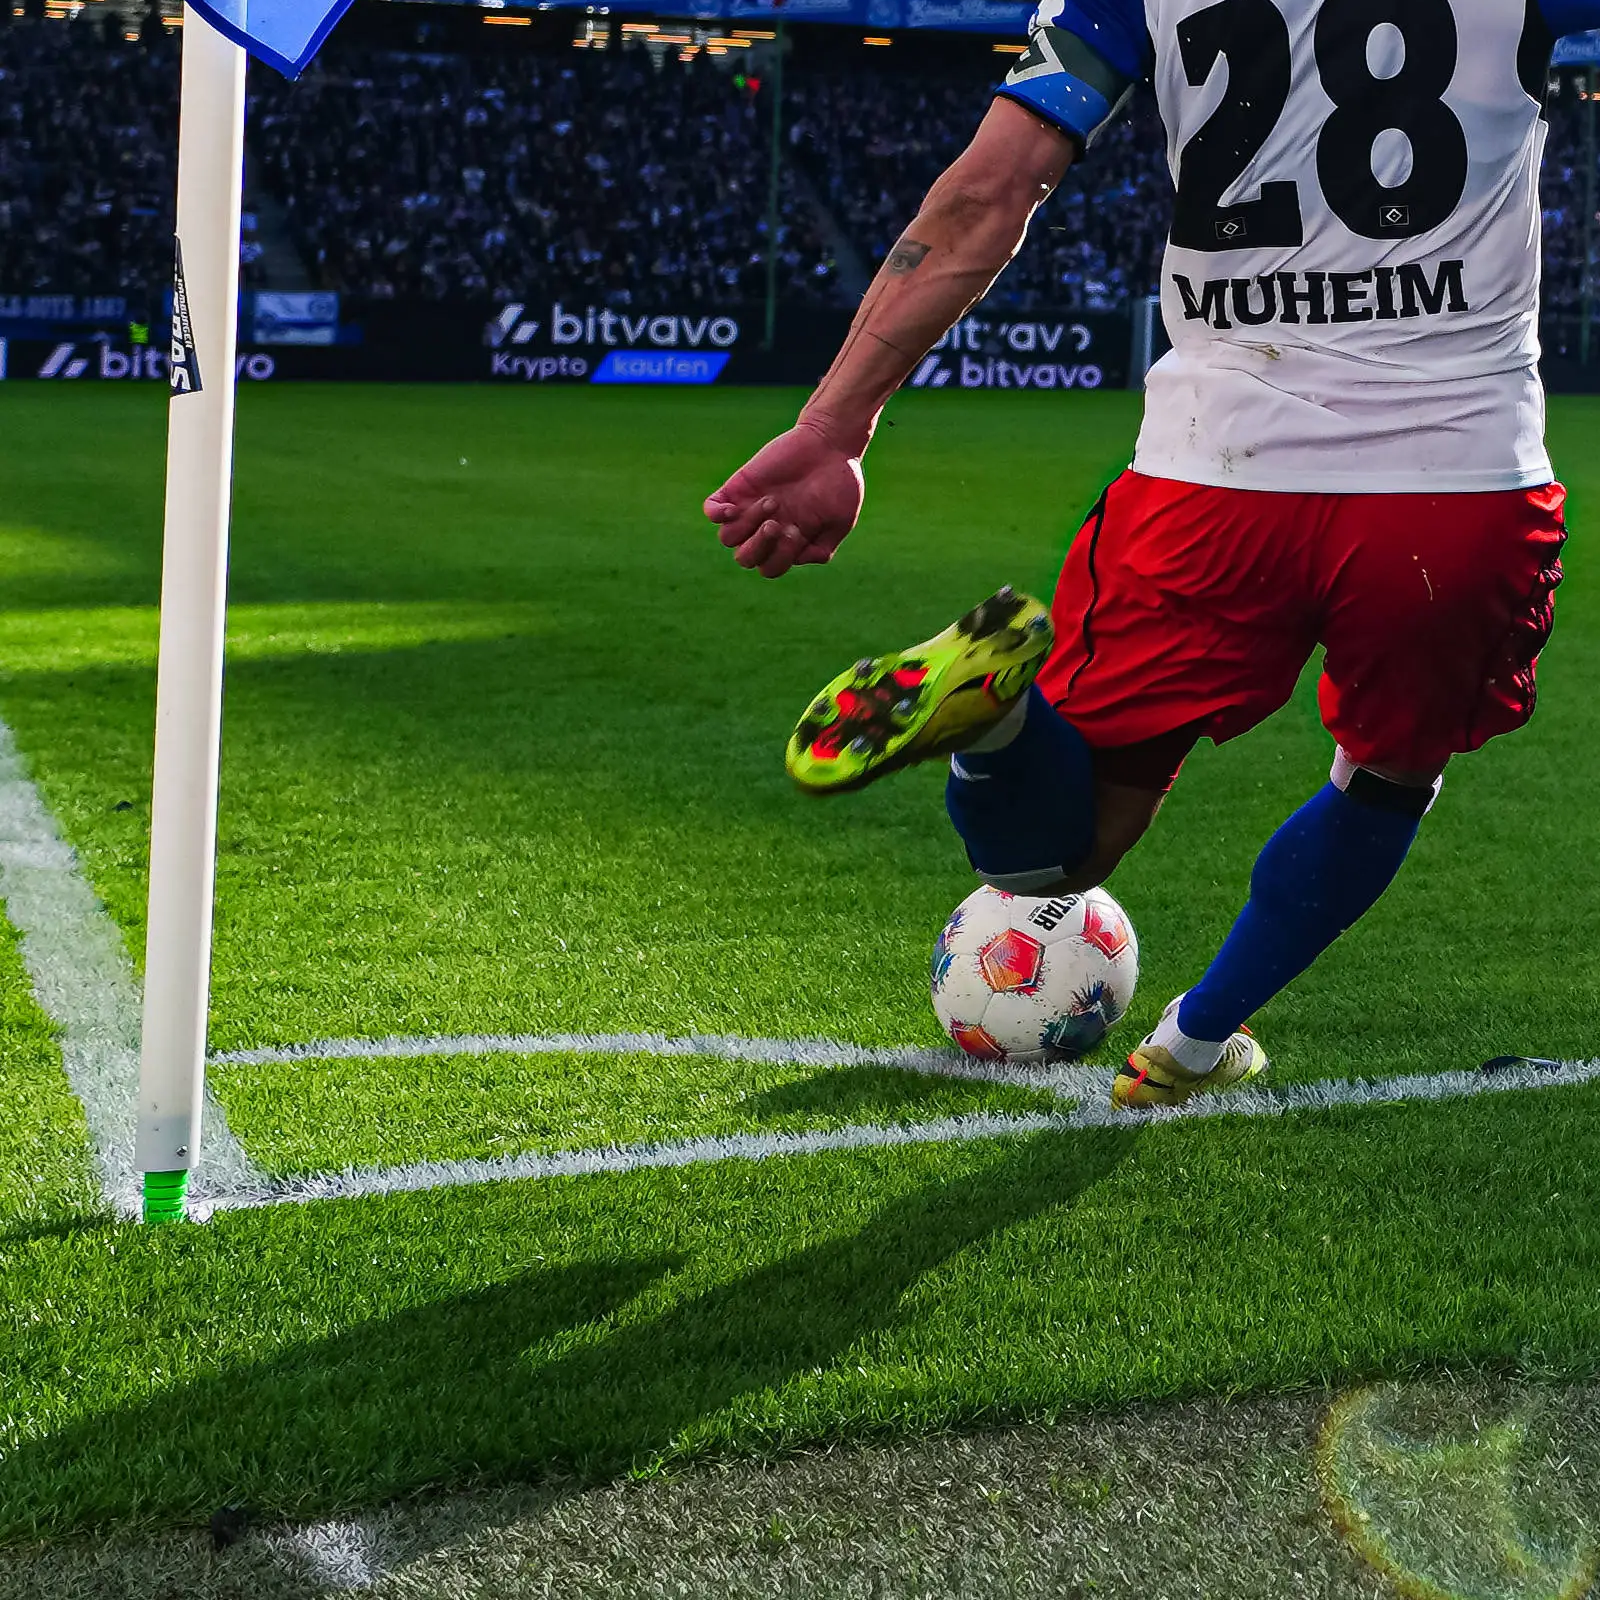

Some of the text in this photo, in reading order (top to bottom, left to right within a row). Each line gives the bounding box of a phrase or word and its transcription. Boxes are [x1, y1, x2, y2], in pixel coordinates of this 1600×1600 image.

[1172, 260, 1467, 330] MUHEIM
[553, 304, 738, 346] bitvavo
[491, 351, 708, 379] Krypto kaufen
[961, 355, 1103, 388] bitvavo
